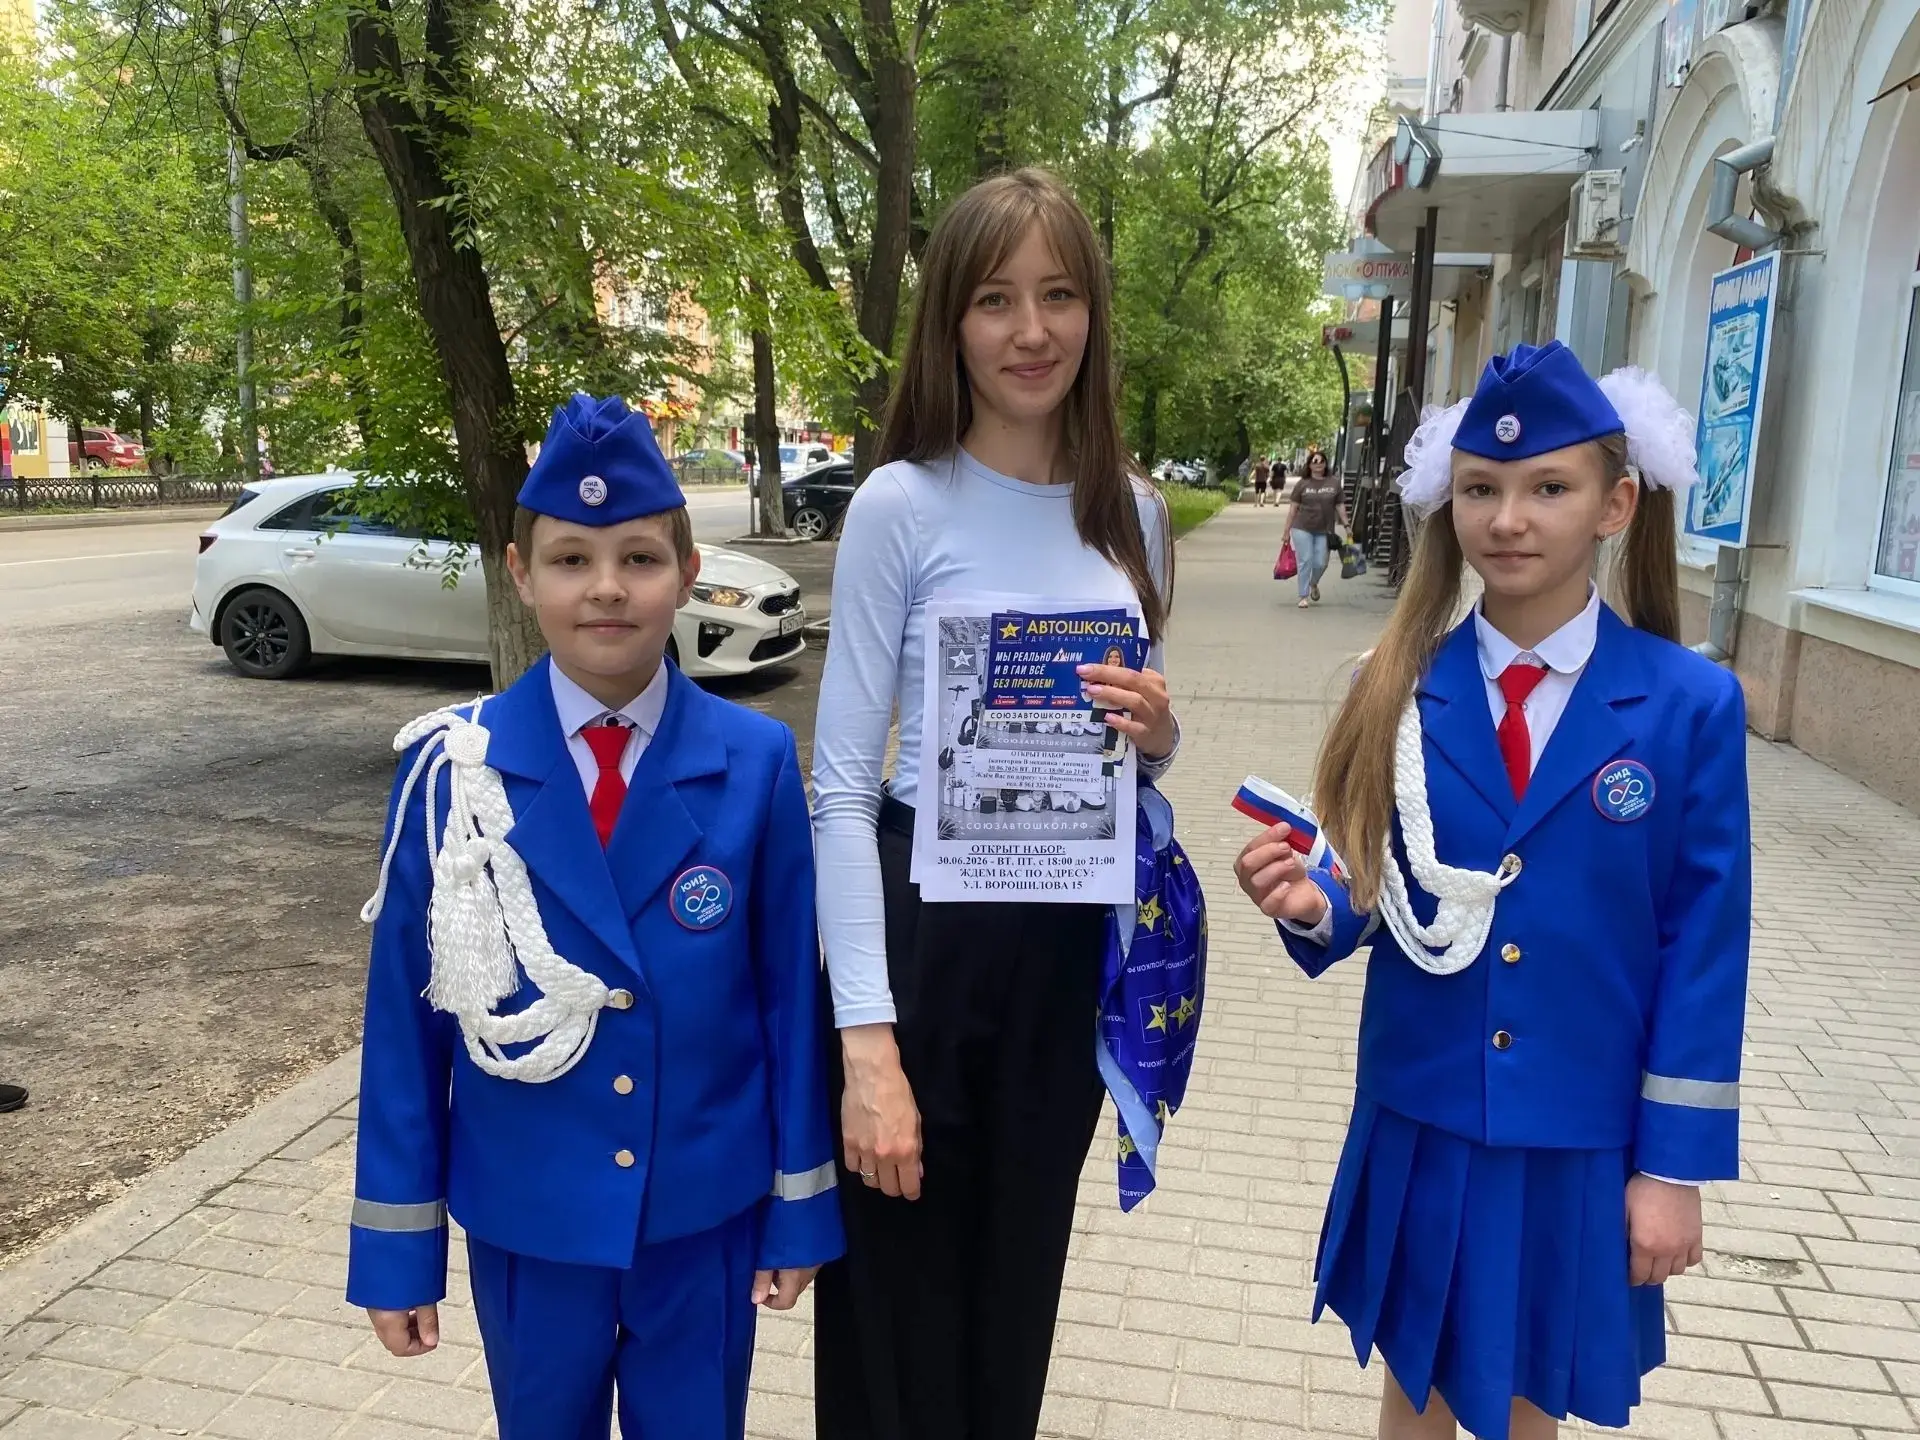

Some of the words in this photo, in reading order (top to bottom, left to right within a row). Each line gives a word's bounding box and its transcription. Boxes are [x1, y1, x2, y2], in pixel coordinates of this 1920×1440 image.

[1363, 261, 1409, 278] ОПТИКА
[1026, 619, 1133, 637] АВТОШКОЛА
[1025, 635, 1043, 643] ГДЕ
[1050, 635, 1099, 644] РЕАЛЬНО
[995, 651, 1011, 662] МЫ
[1012, 651, 1052, 662] РЕАЛЬНО
[994, 665, 1001, 675] И
[1002, 665, 1009, 675] В
[1010, 665, 1028, 675] ГАИ
[1029, 664, 1046, 675] ВСЁ
[992, 678, 1010, 689] БЕЗ
[1011, 678, 1055, 689] ПРОБЛЕМ!
[1603, 767, 1631, 785] ЮИД
[966, 822, 1088, 830] СОЮЗАВТОШКОЛ.РФ
[971, 844, 1020, 854] ОТКРЫТ
[1023, 844, 1066, 854] НАБОР:
[937, 857, 988, 865] 30.06.2026
[997, 857, 1014, 866] ВТ.
[1017, 857, 1036, 866] ПТ.
[1047, 856, 1073, 866] 18:00
[1075, 859, 1086, 867] до
[1089, 857, 1115, 866] 21:00
[960, 868, 996, 878] ЖДЕМ
[999, 868, 1023, 878] ВАС
[1025, 868, 1042, 878] ПО
[1045, 868, 1094, 879] АДРЕСУ:
[681, 873, 708, 892] ЮИД
[963, 881, 982, 890] УЛ.
[985, 881, 1068, 890] ВОРОШИЛОВА
[1072, 881, 1083, 890] 15
